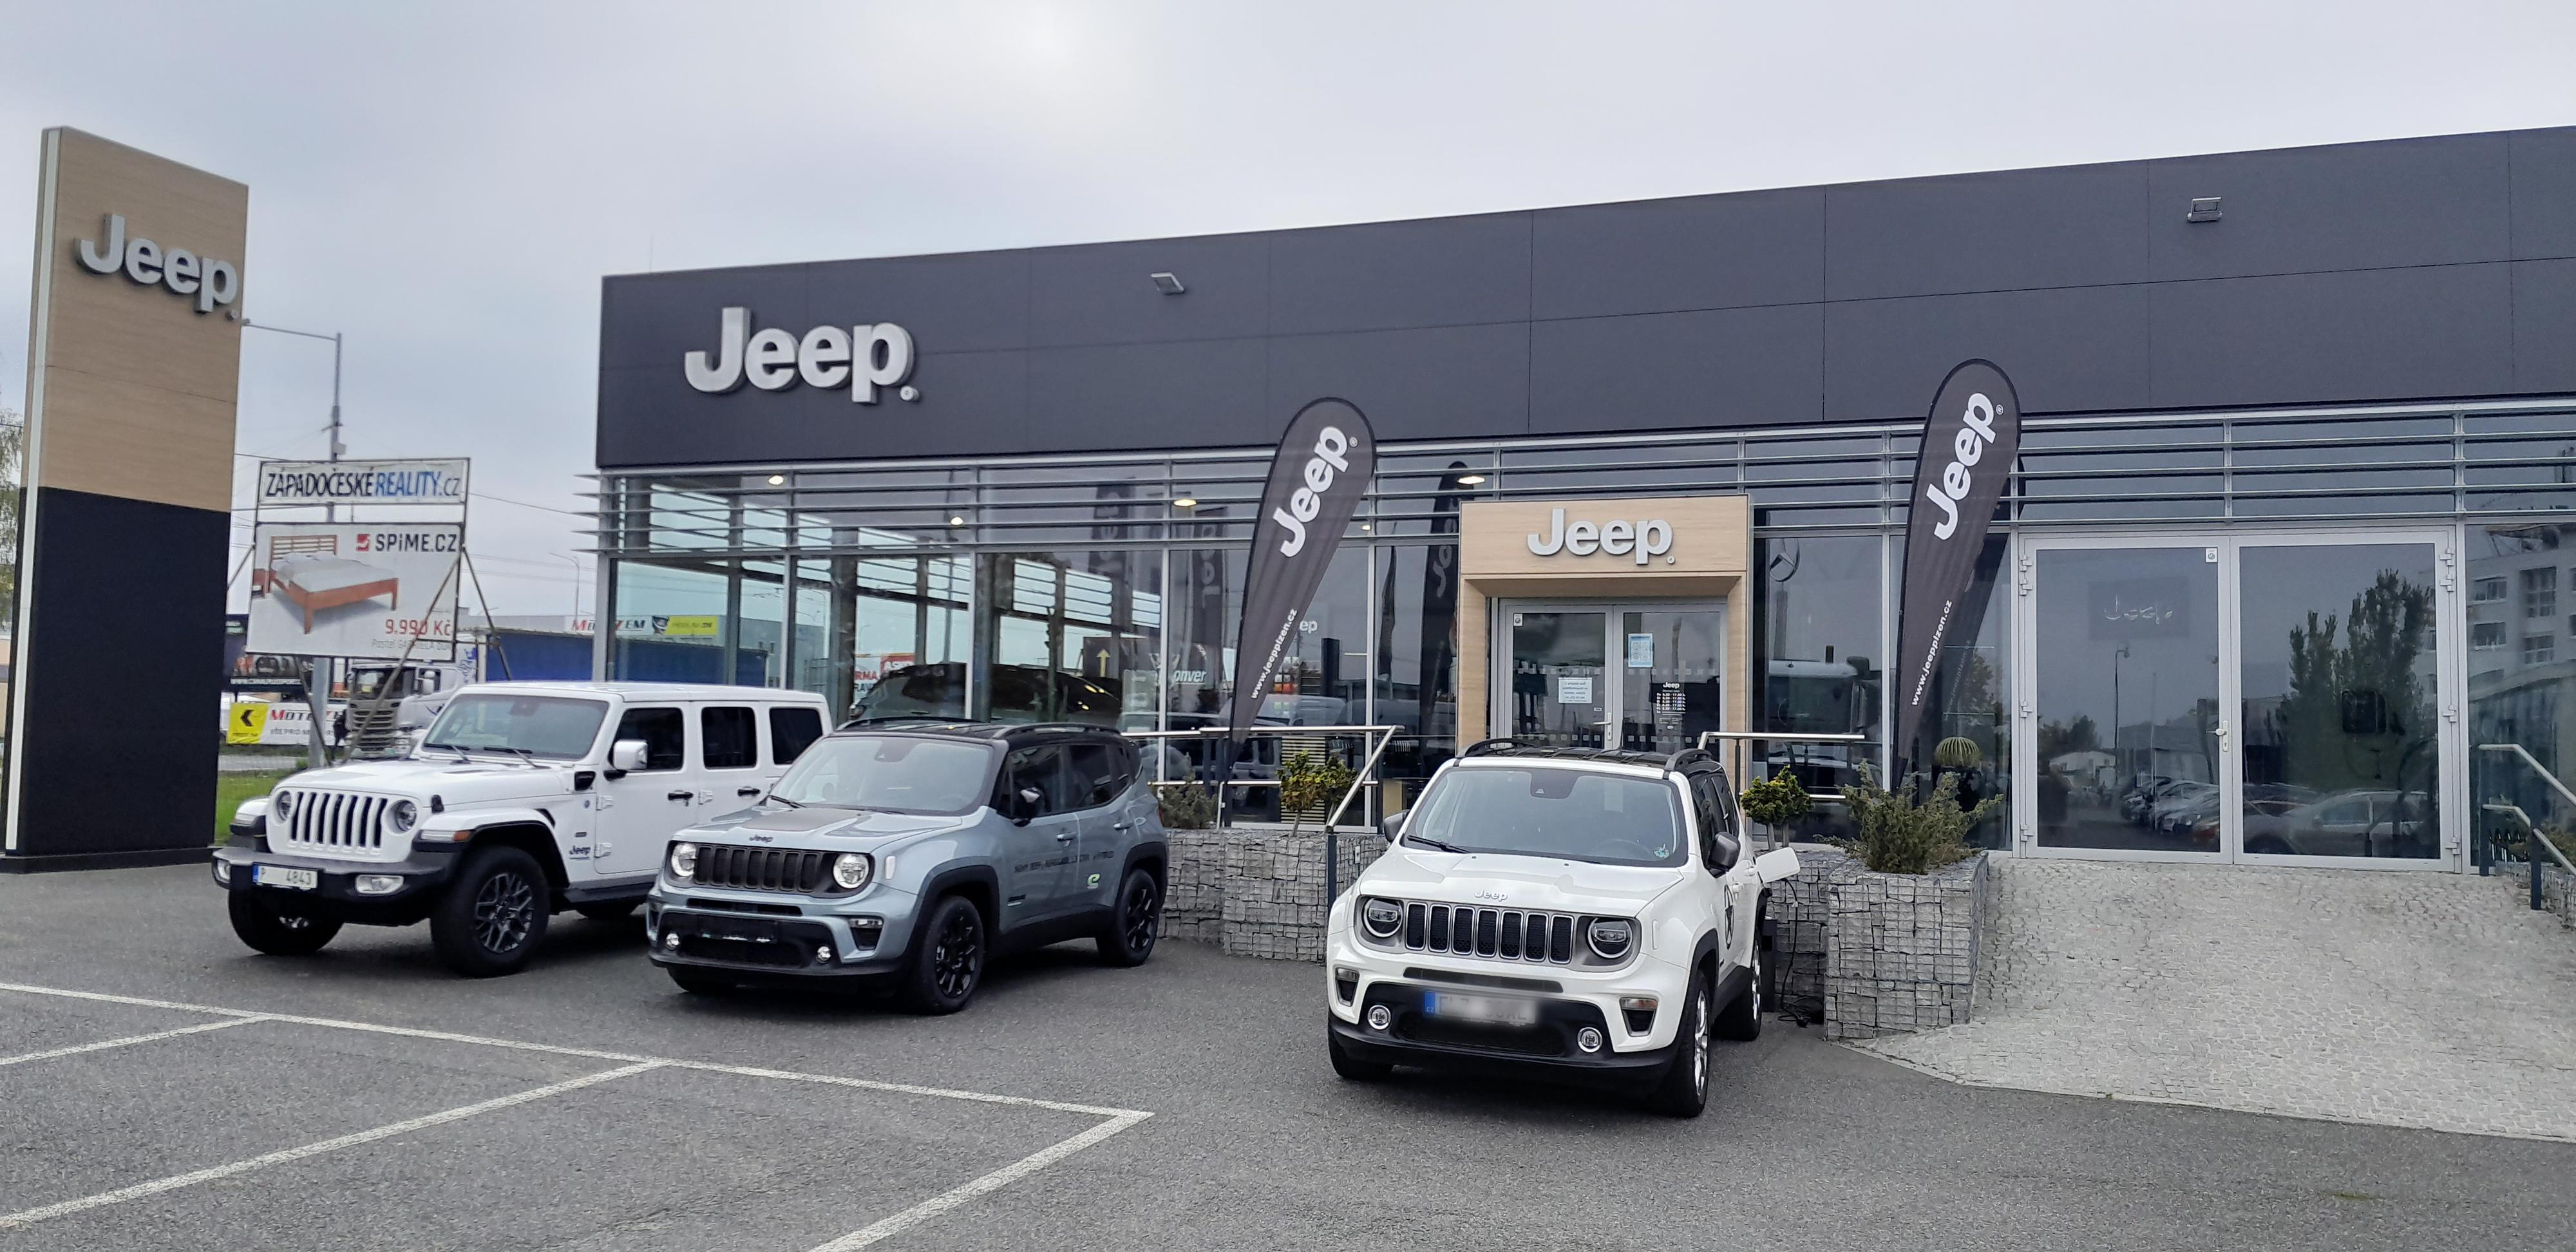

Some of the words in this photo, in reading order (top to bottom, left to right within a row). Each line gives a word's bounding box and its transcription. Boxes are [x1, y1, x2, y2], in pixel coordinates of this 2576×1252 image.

[75, 213, 238, 314] Jeep
[685, 307, 913, 404] Jeep
[1273, 426, 1349, 558] Jeep
[1926, 392, 1996, 540] Jeep
[1527, 507, 1673, 565] Jeep
[433, 620, 451, 636] Kč
[1299, 620, 1318, 634] ep
[1475, 887, 1508, 902] Jeep
